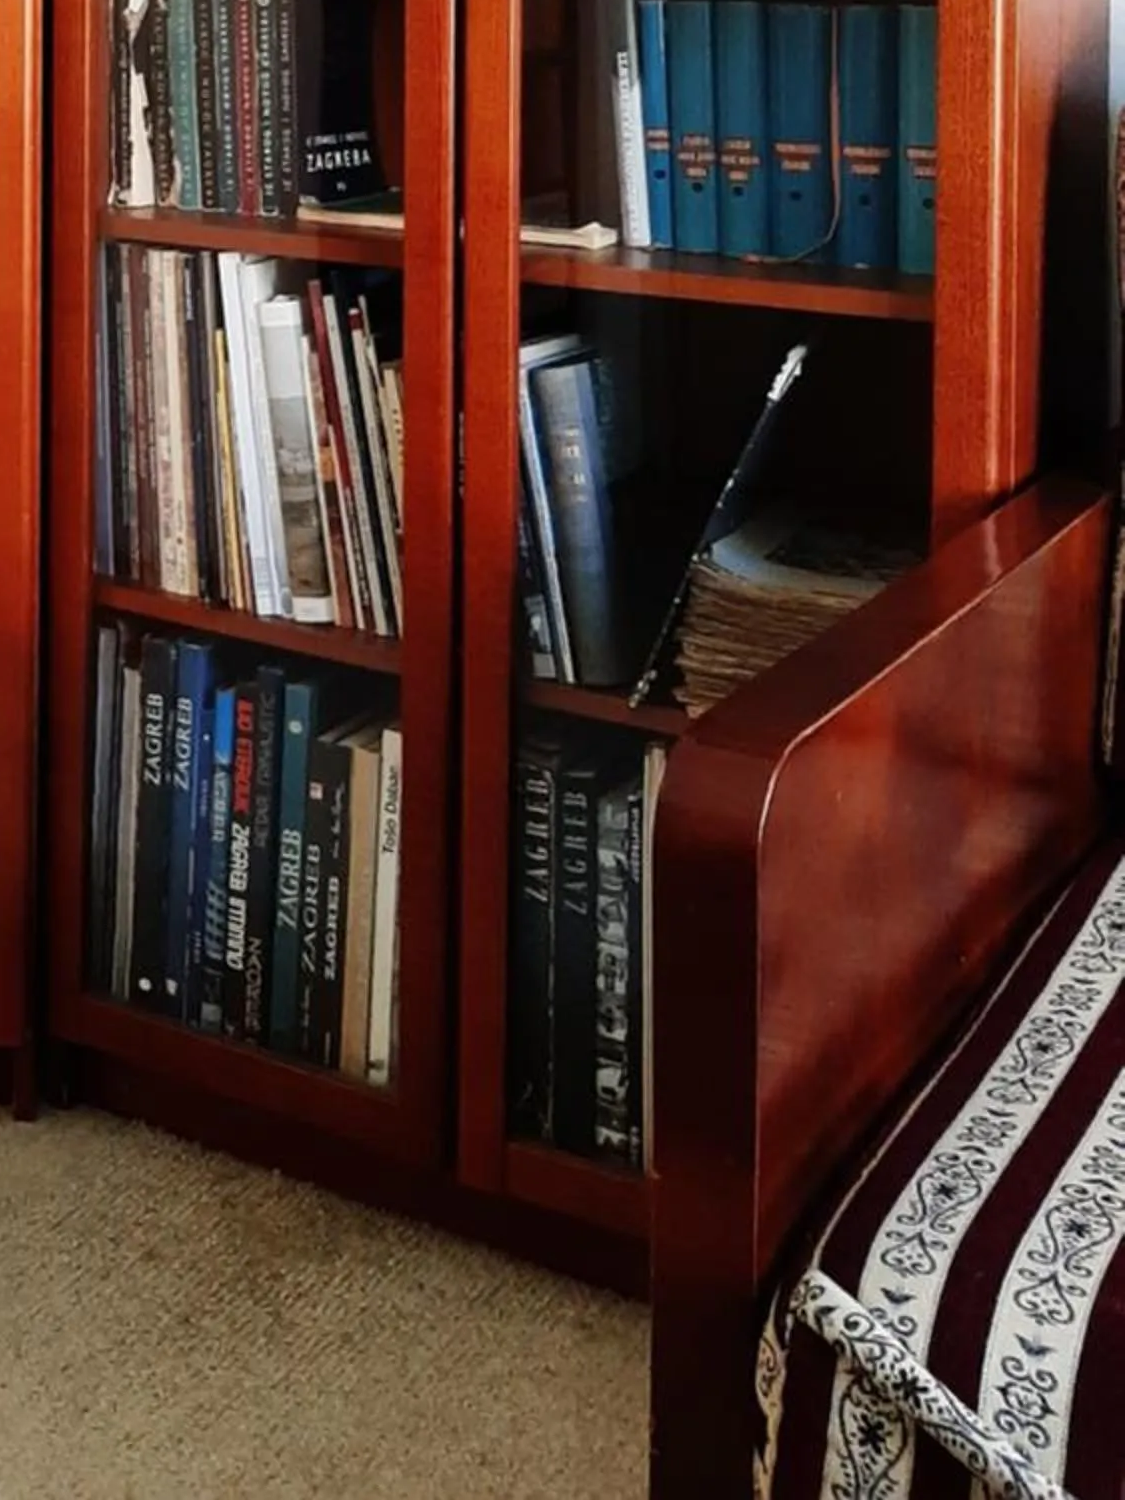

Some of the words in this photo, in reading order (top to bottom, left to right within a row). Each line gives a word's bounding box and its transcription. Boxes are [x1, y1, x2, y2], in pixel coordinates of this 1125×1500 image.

[305, 148, 372, 173] ZAGREBA
[144, 692, 164, 786] ZAGREB
[173, 696, 193, 792] ZAGREB
[230, 822, 251, 892] ZAGREB
[275, 827, 302, 930] ZAGREB
[381, 819, 397, 855] Tošo
[524, 776, 550, 903] ZAGREB
[561, 789, 589, 915] ZAGREB
[301, 842, 321, 975] ZAGREB
[323, 875, 340, 981] ZAGREB
